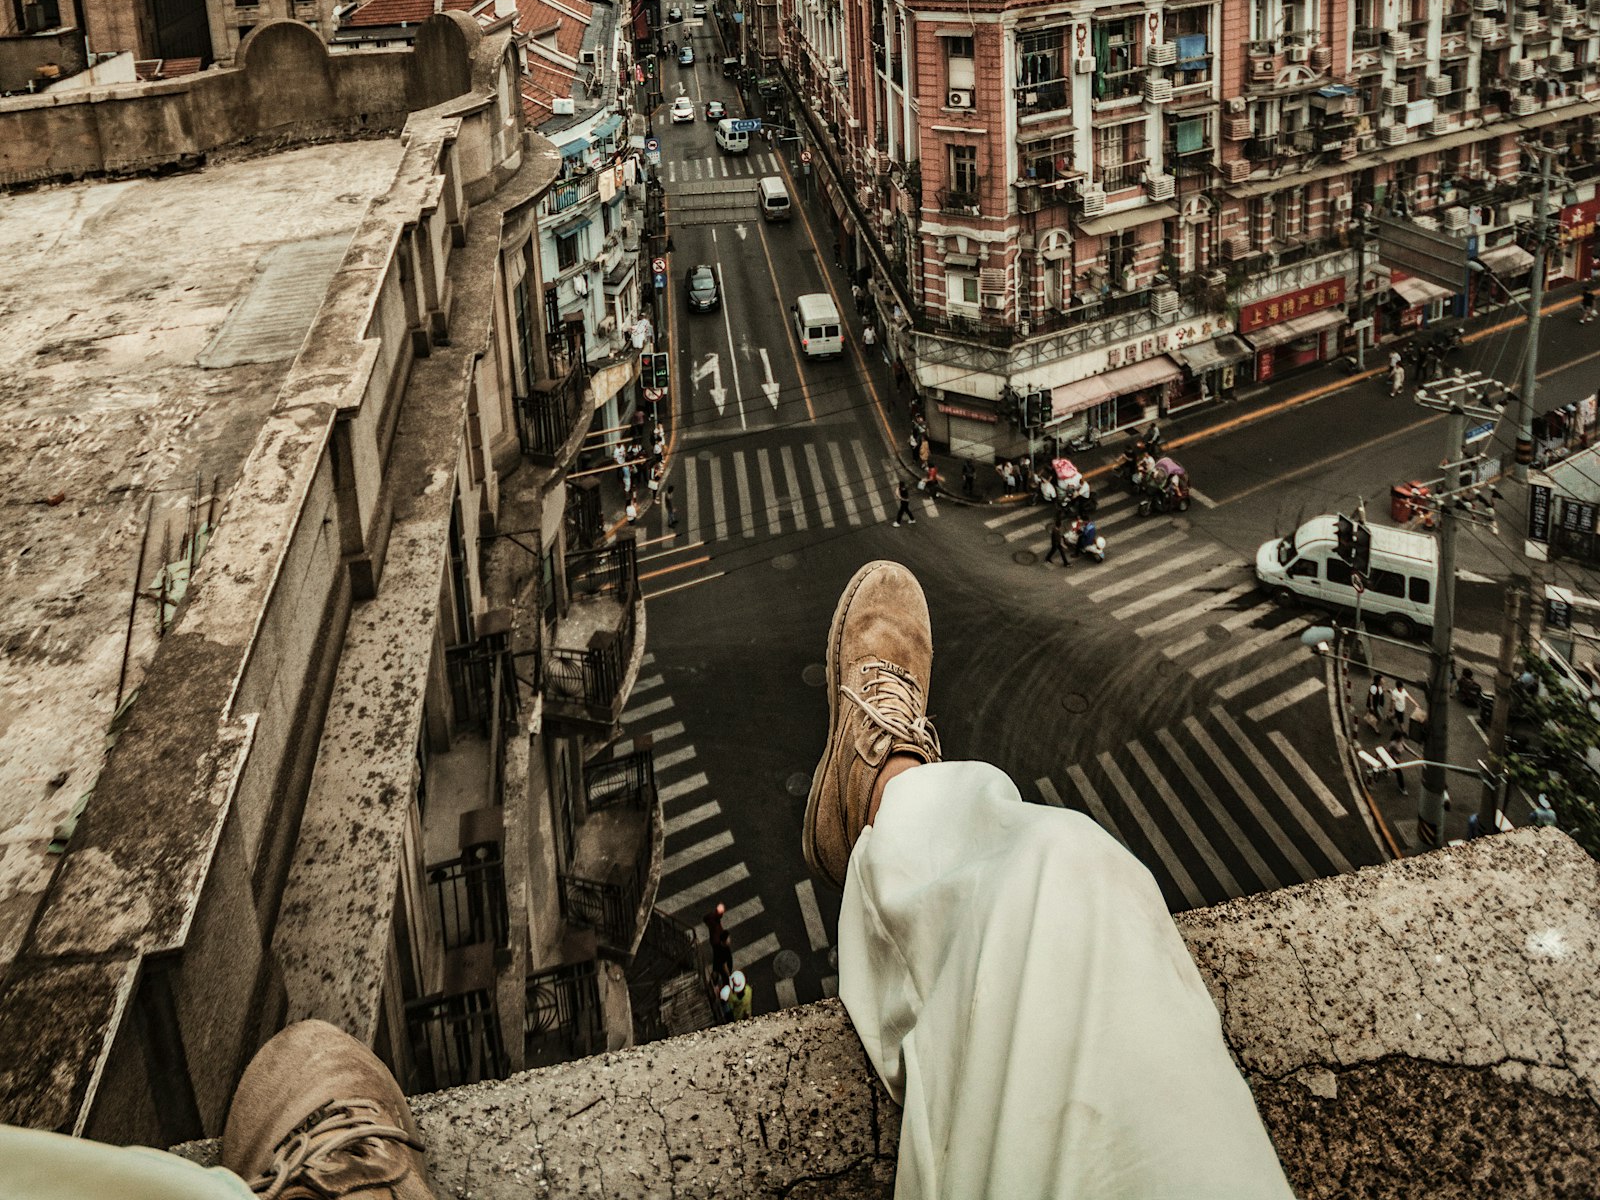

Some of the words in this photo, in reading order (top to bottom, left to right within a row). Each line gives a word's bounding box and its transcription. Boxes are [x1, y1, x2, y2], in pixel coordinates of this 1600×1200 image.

[1250, 286, 1339, 326] 上海特产超市
